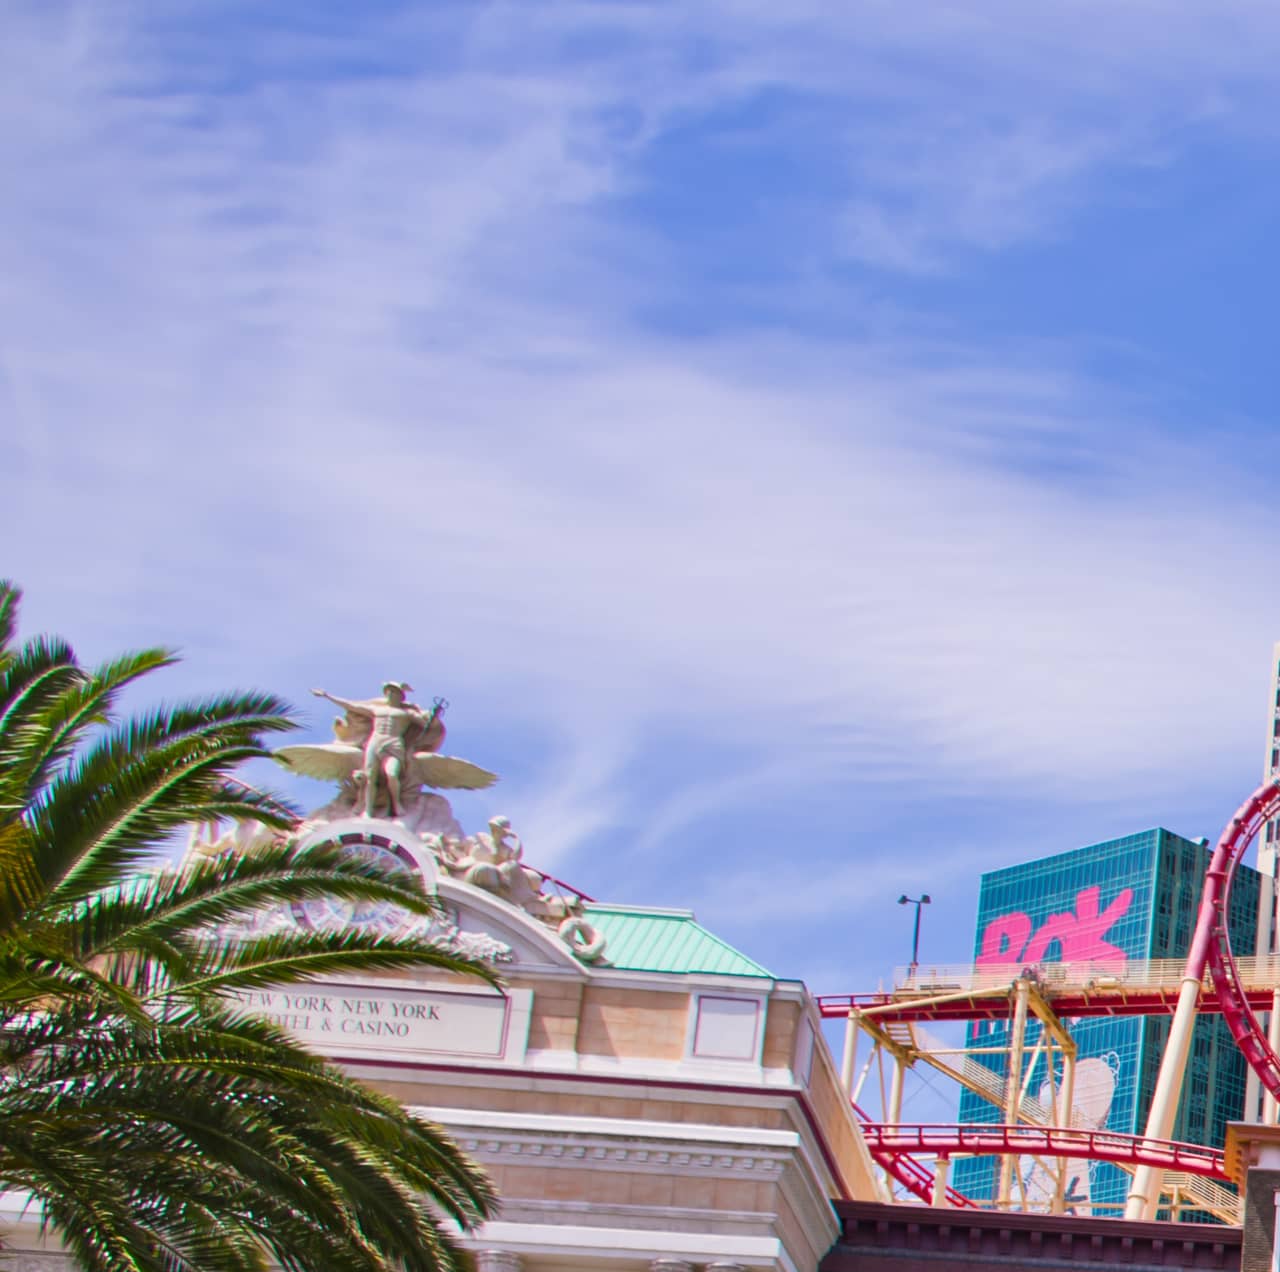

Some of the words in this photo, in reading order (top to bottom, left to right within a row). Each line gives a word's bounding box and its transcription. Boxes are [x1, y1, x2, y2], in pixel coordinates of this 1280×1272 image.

[283, 995, 333, 1013] YORK
[340, 1000, 383, 1015] NEW
[390, 1002, 441, 1021] YORK
[320, 1018, 332, 1031] &
[341, 1018, 410, 1037] CASINO
